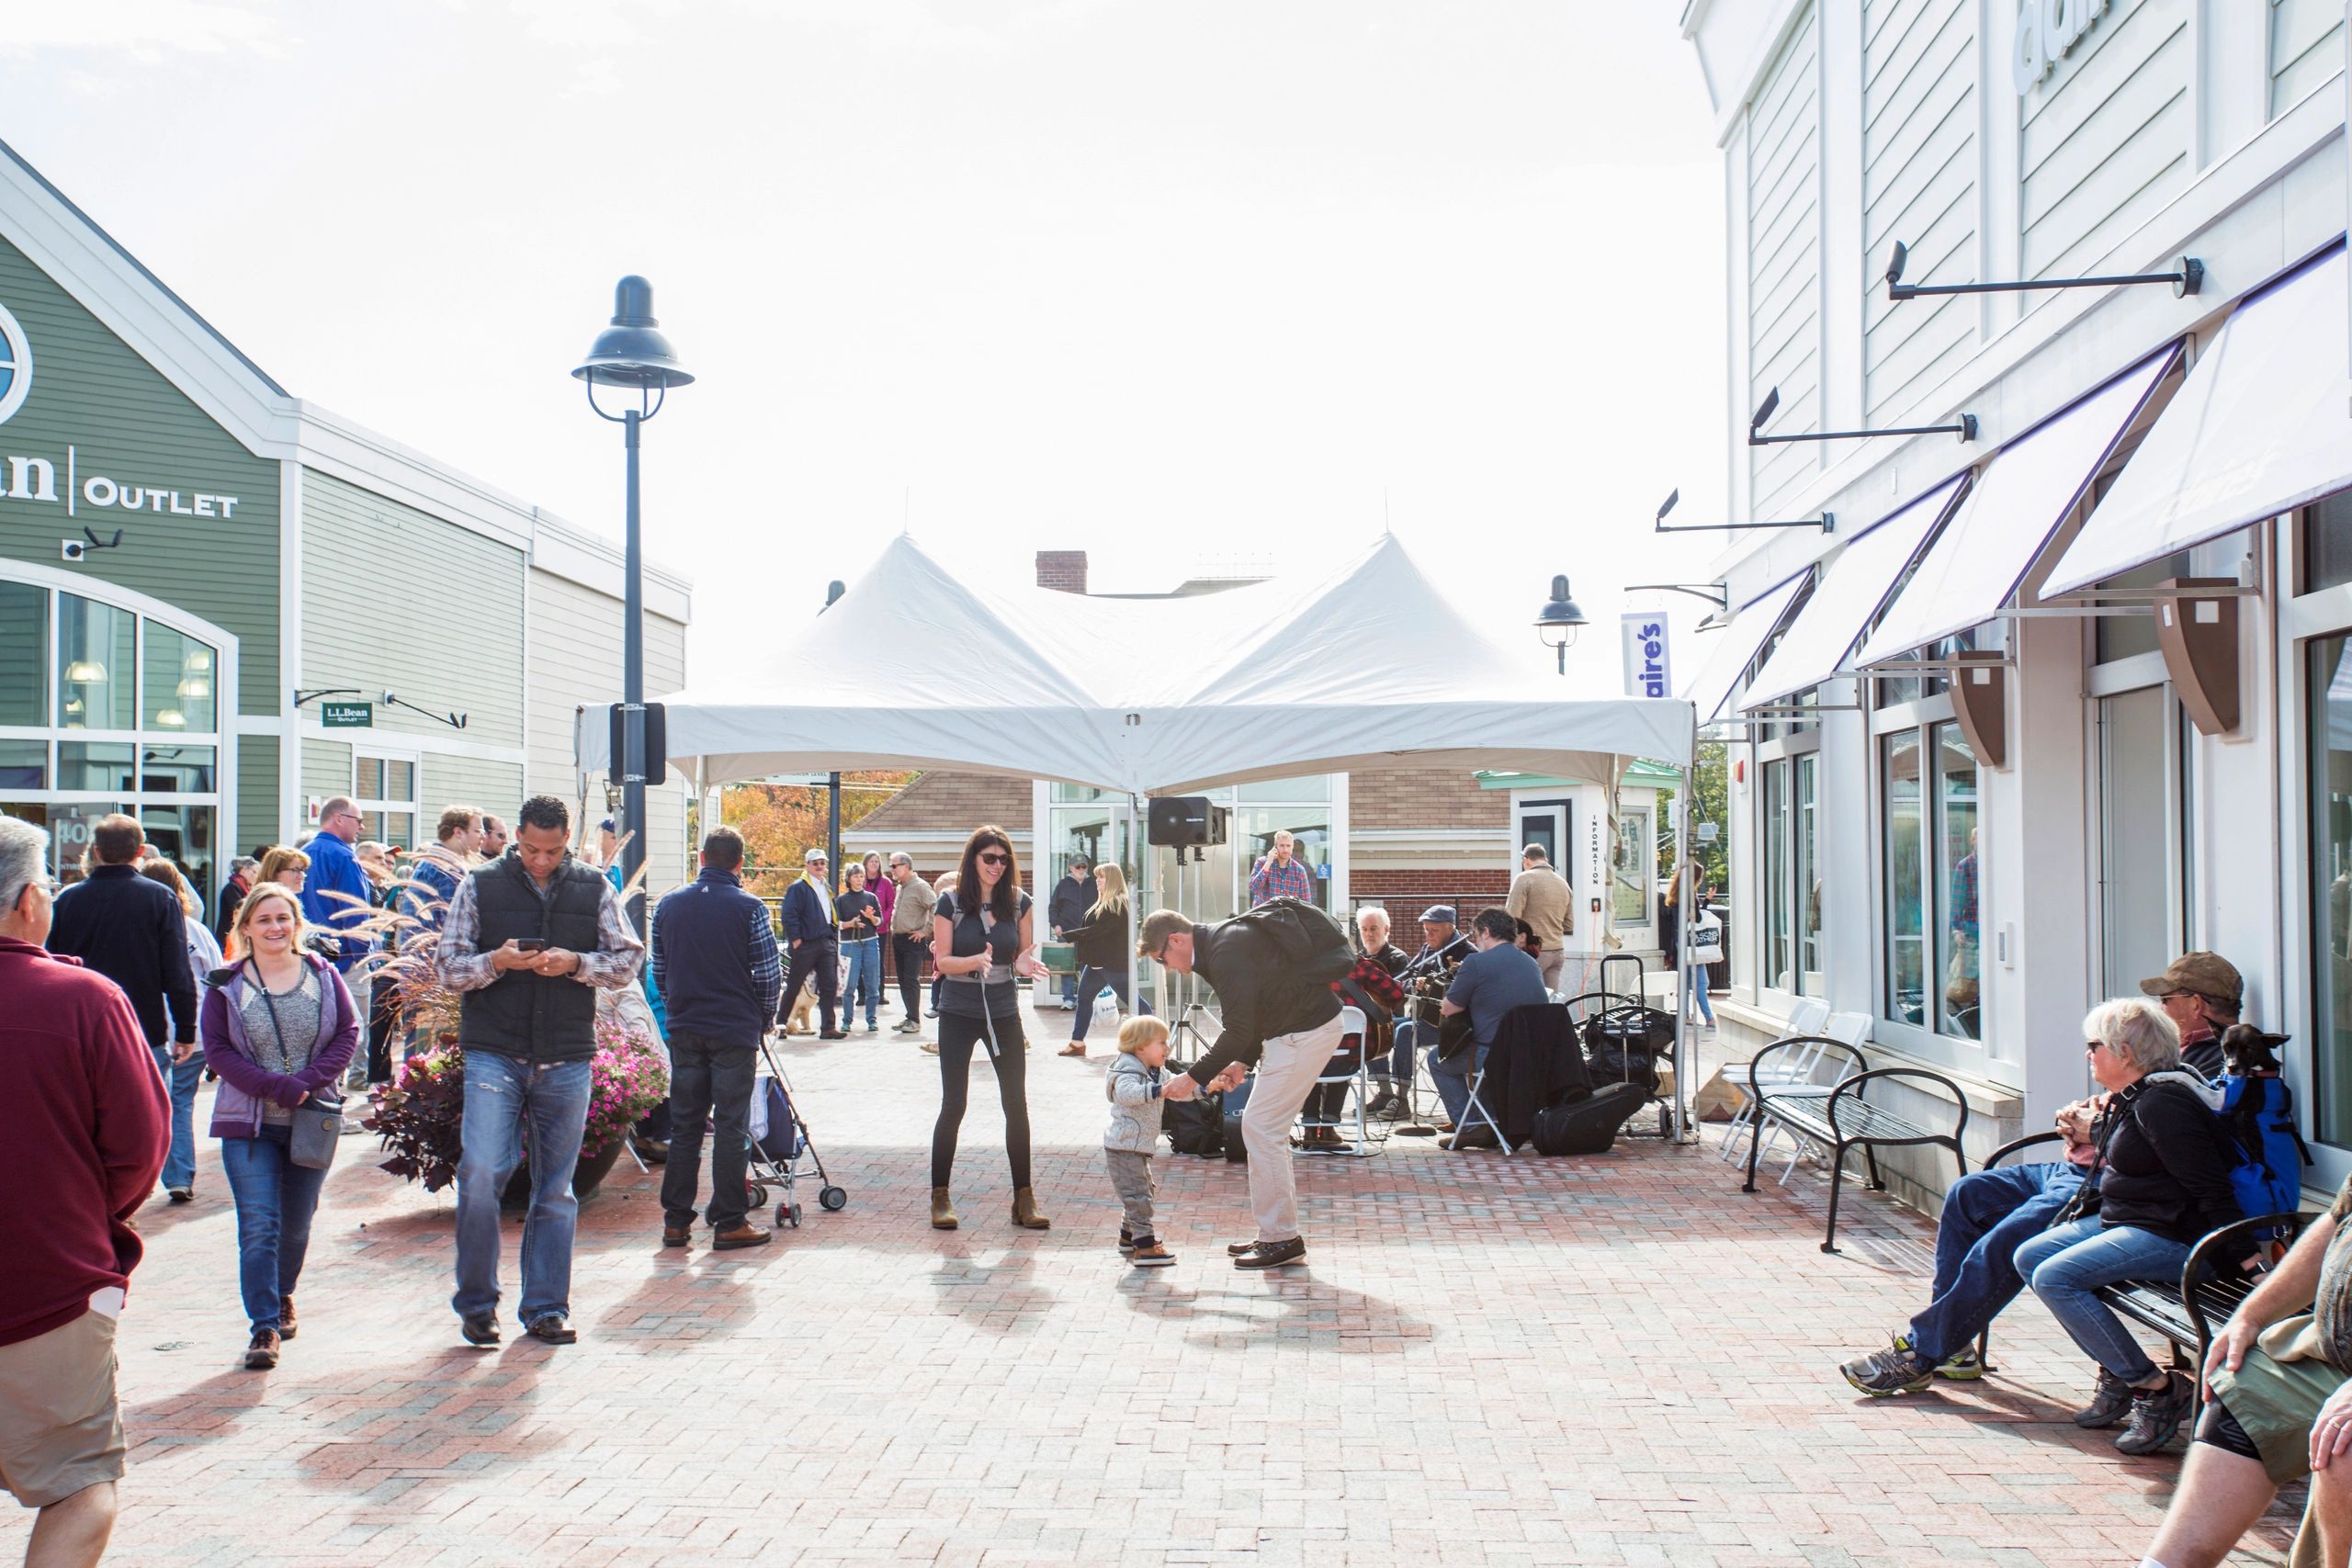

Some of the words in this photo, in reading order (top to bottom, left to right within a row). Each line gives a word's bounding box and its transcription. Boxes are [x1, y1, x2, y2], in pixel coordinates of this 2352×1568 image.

[0, 456, 58, 502] n
[84, 477, 238, 518] OUTLET
[1637, 623, 1664, 698] aire's
[327, 708, 368, 716] L.L.Bean
